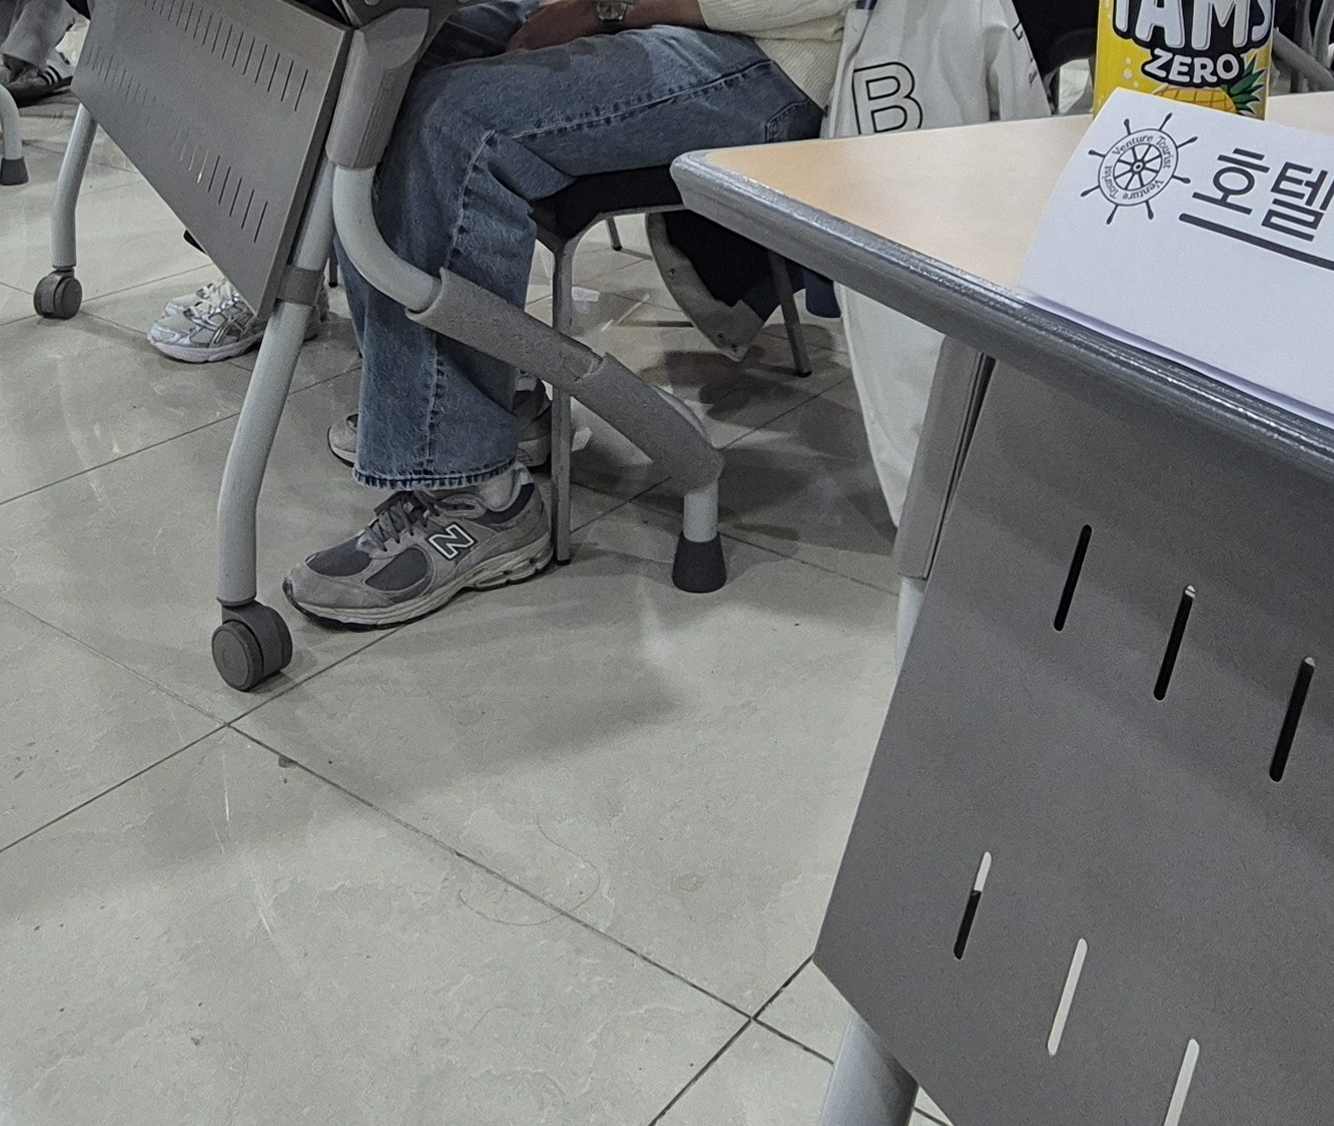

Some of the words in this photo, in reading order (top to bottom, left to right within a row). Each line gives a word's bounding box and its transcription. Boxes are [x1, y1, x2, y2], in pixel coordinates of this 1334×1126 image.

[1144, 48, 1239, 83] ZERO
[1112, 135, 1154, 155] Venture
[1156, 135, 1174, 169] Tourist
[1122, 179, 1164, 200] Venture
